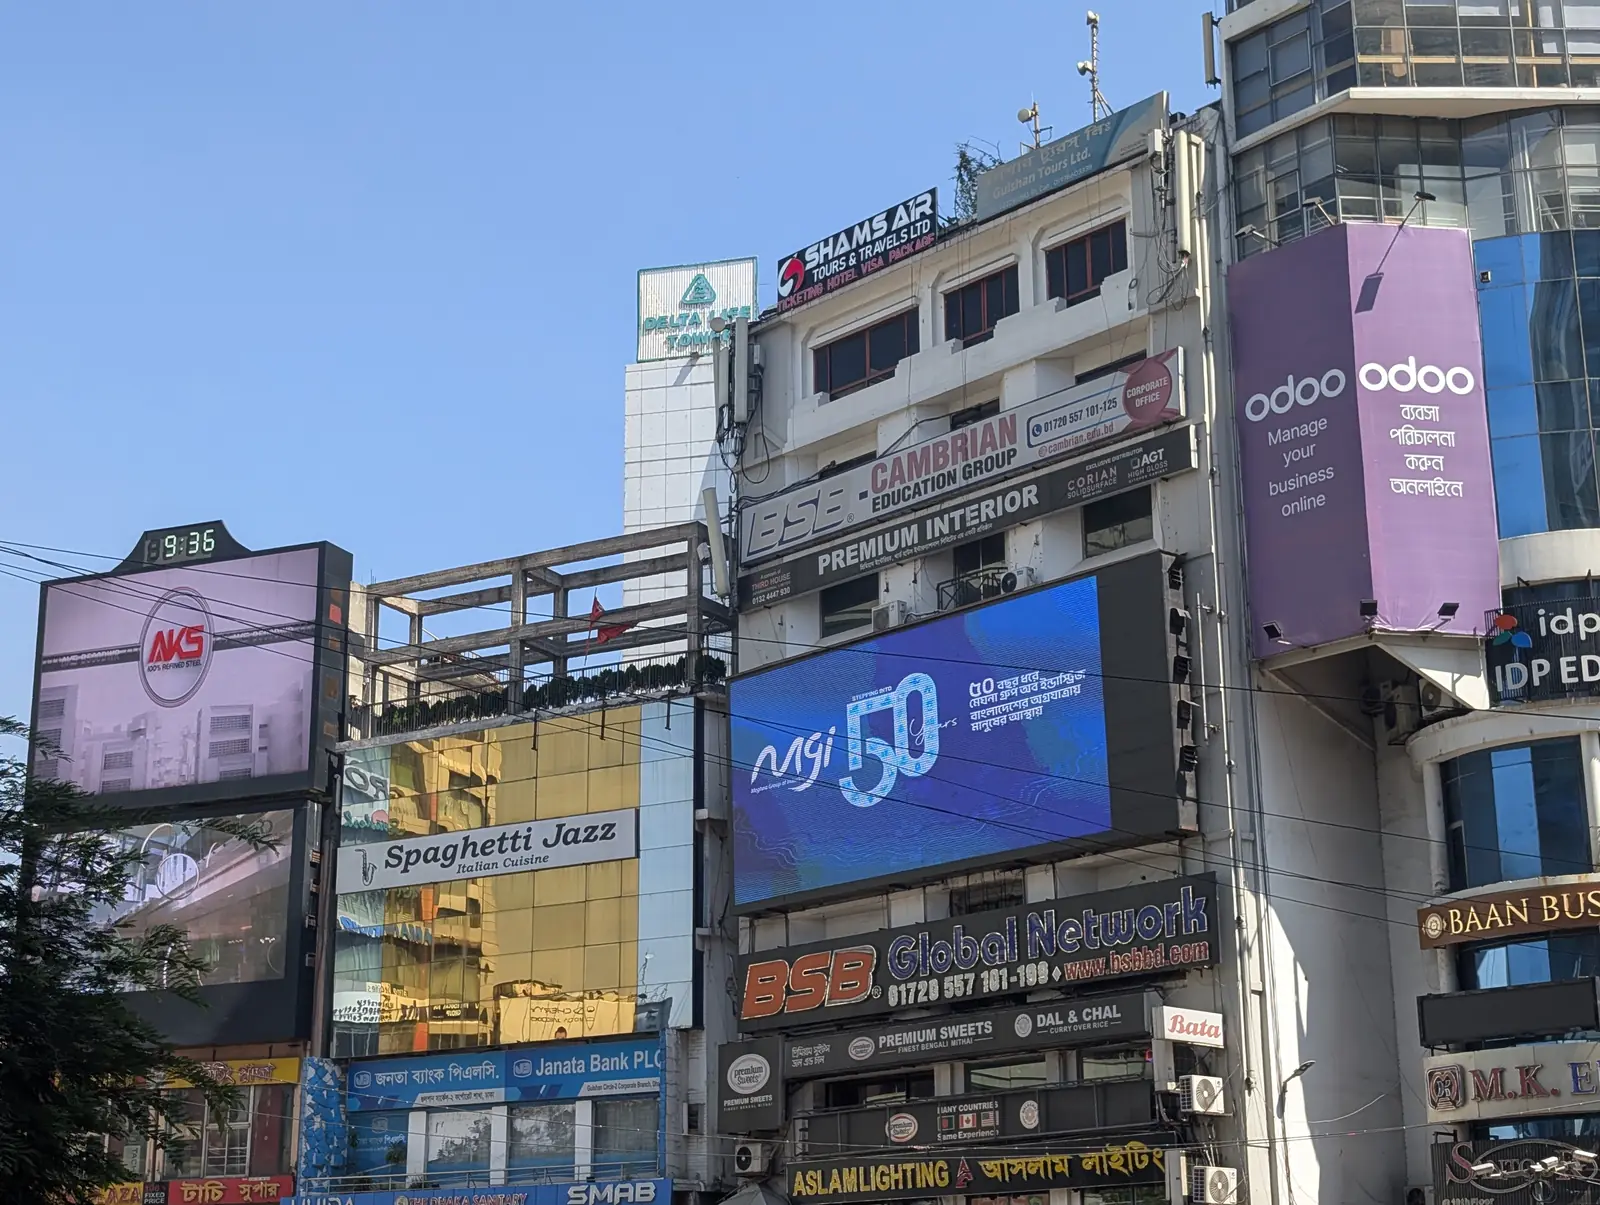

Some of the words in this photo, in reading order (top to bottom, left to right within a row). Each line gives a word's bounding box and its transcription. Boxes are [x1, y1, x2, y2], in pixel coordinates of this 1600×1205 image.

[992, 172, 1036, 199] Gulshan
[1038, 158, 1068, 181] Tours
[1070, 147, 1092, 168] Ltd.
[804, 211, 888, 271] SHAMS
[891, 192, 934, 231] AIR
[812, 257, 846, 283] TOURS
[848, 252, 857, 267] &
[858, 228, 908, 260] TRAVELS
[910, 218, 931, 240] LTD
[777, 282, 824, 313] TICKETING
[827, 270, 858, 291] HOTEL
[860, 258, 884, 276] VISA
[645, 311, 701, 330] DELTA
[1126, 376, 1169, 399] CORPORATE
[1359, 355, 1475, 395] odoo
[1135, 391, 1161, 408] OFFICE
[1245, 368, 1346, 422] odoo
[1043, 415, 1068, 433] 01720
[1069, 409, 1083, 424] 557
[1085, 397, 1118, 419] 101-125
[1399, 404, 1440, 423] ব্যবসা
[1267, 416, 1328, 446] Manage
[1389, 424, 1456, 448] পরিচালনা
[871, 413, 1018, 494] CAMBRIAN
[1085, 457, 1112, 471] EXCLUSIVE
[1111, 447, 1144, 463] DISTRIBUTOR
[1140, 447, 1165, 467] AGT
[1282, 442, 1317, 468] your
[1403, 453, 1445, 472] করুন
[871, 468, 957, 513] EDUCATION
[961, 447, 1018, 481] GROUP
[1067, 465, 1118, 491] CORIAN
[1127, 467, 1145, 479] HIGH
[1146, 460, 1168, 473] GLOSS
[1268, 464, 1335, 496] business
[1389, 476, 1464, 498] অনলাইনে
[1281, 492, 1326, 517] online
[818, 523, 919, 576] PREMIUM
[926, 483, 1040, 540] INTERIOR
[165, 529, 215, 557] 9:36
[752, 579, 769, 592] THIRD
[770, 572, 791, 585] HOUSE
[1537, 607, 1600, 641] idp
[148, 624, 204, 664] AKS
[162, 661, 184, 671] REFINED
[185, 659, 202, 668] STEEL
[1494, 658, 1551, 692] IDP
[1559, 654, 1600, 684] ED
[969, 677, 995, 697] ৫০
[997, 676, 1019, 690] বছর
[1020, 670, 1040, 683] ধরে
[969, 692, 998, 709] মেঘনা
[999, 686, 1018, 701] গ্রুপ
[1019, 682, 1038, 694] অব
[969, 697, 1029, 720] বাংলাদেশের
[970, 714, 1007, 733] মানুষের
[384, 826, 532, 873] Spaghetti
[542, 819, 618, 850] Jazz
[455, 859, 499, 875] Italian
[502, 853, 550, 869] Cuisine
[1448, 897, 1530, 936] BAAN
[1540, 890, 1600, 922] BUS
[887, 916, 1017, 980] Global
[1026, 886, 1208, 957] Network
[888, 975, 939, 1007] 01720
[943, 972, 975, 998] 557
[1063, 940, 1210, 981] www.bsbbd.com
[1036, 1012, 1064, 1028] DAL
[1067, 1009, 1079, 1024] &
[1082, 1004, 1122, 1022] CHAL
[1049, 1025, 1072, 1035] CURRY
[1073, 1023, 1091, 1032] OVER
[1092, 1021, 1109, 1030] RICE
[1167, 1013, 1221, 1039] Bata
[878, 1028, 936, 1049] PREMIUM
[939, 1020, 993, 1039] SWEETS
[897, 1043, 919, 1054] FINEST
[920, 1041, 949, 1051] BENGALI
[950, 1037, 973, 1047] MITHAI
[374, 1069, 408, 1087] জনতা
[411, 1067, 446, 1085] ব্যাংক
[448, 1060, 500, 1082] পিএলসি.
[535, 1056, 585, 1077] Janata
[590, 1051, 629, 1073] Bank
[618, 1081, 636, 1091] Corporate
[1468, 1063, 1561, 1103] M.K.
[1567, 1059, 1600, 1096] E
[723, 1097, 749, 1107] PREMIUM
[750, 1094, 773, 1104] SWEETS
[937, 1132, 957, 1141] Same
[977, 1151, 1074, 1183] আসলাম
[1080, 1140, 1166, 1178] লাইটিং
[181, 1180, 228, 1204] টাচি
[238, 1181, 281, 1202] সুপার
[567, 1181, 656, 1205] SMAB
